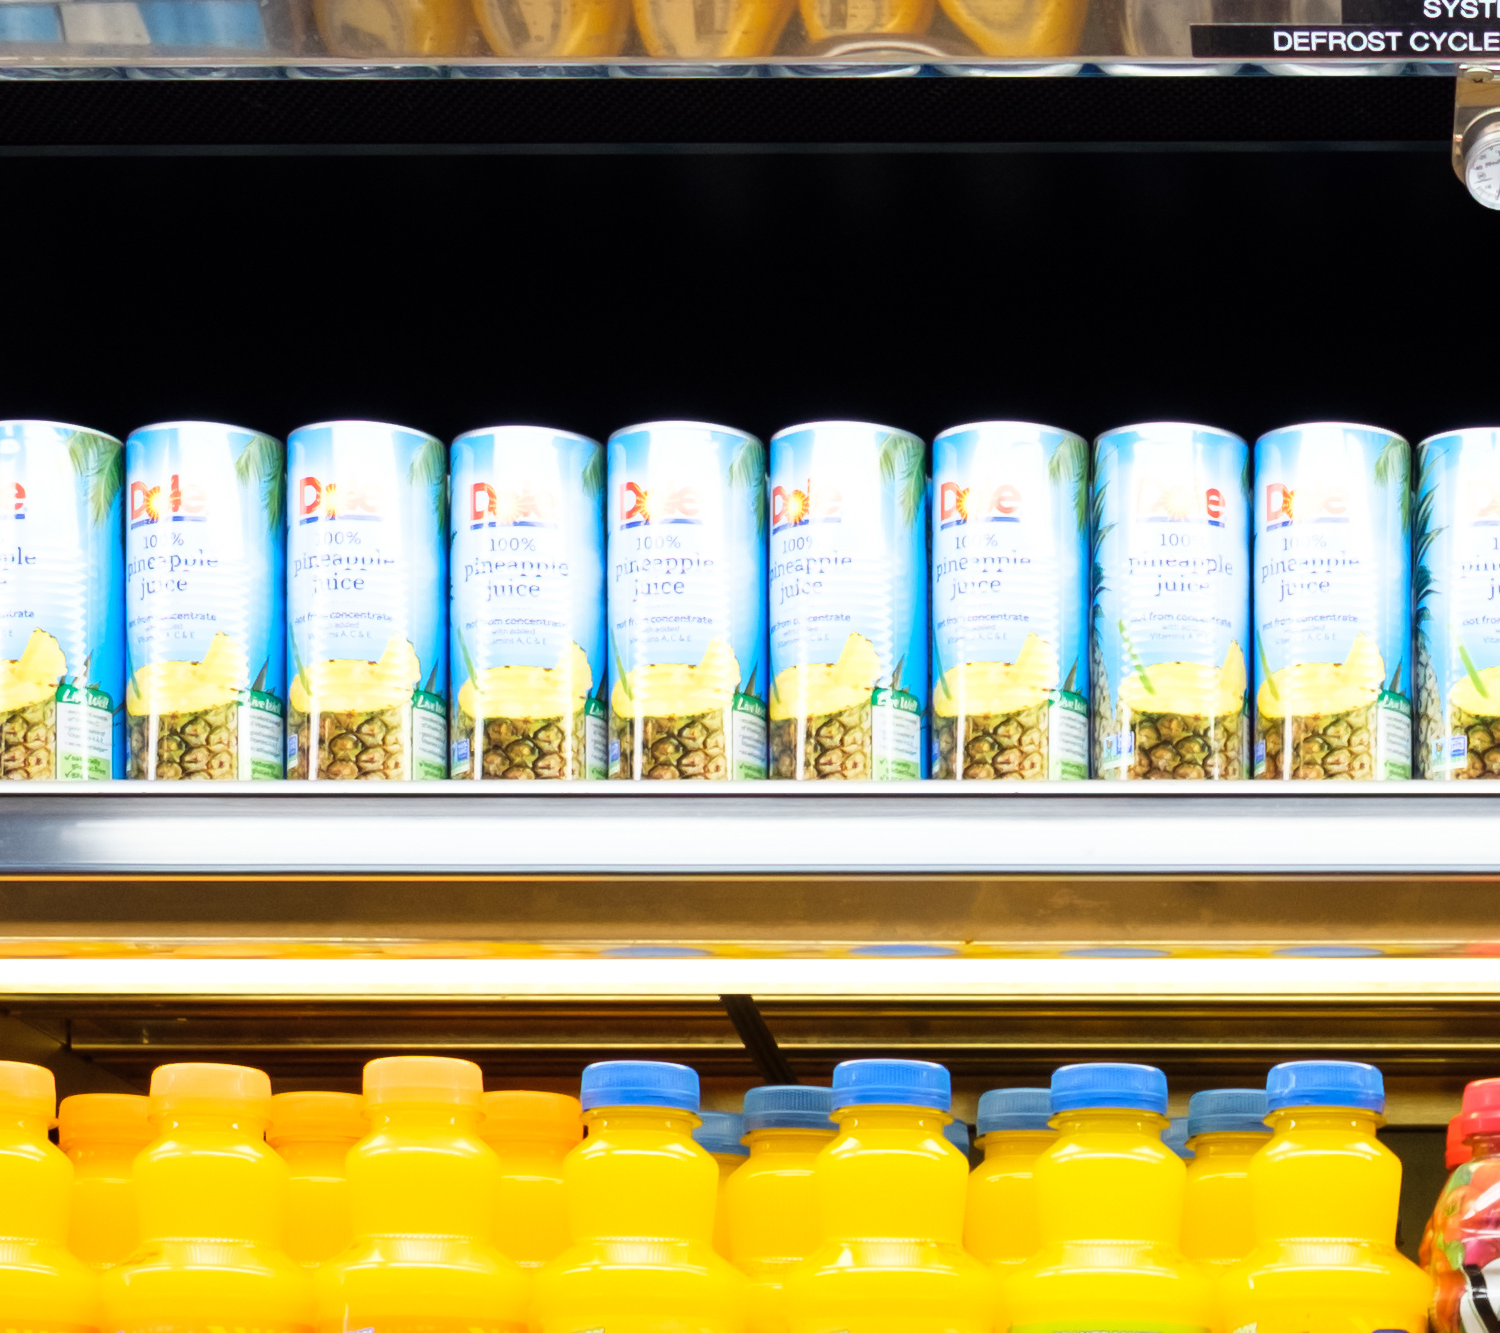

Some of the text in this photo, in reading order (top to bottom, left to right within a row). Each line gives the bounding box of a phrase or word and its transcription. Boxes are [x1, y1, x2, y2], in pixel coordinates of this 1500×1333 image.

[1273, 31, 1403, 52] DEFROST
[1409, 31, 1500, 52] CYCLE
[490, 538, 536, 551] 100%
[487, 578, 540, 602] juice
